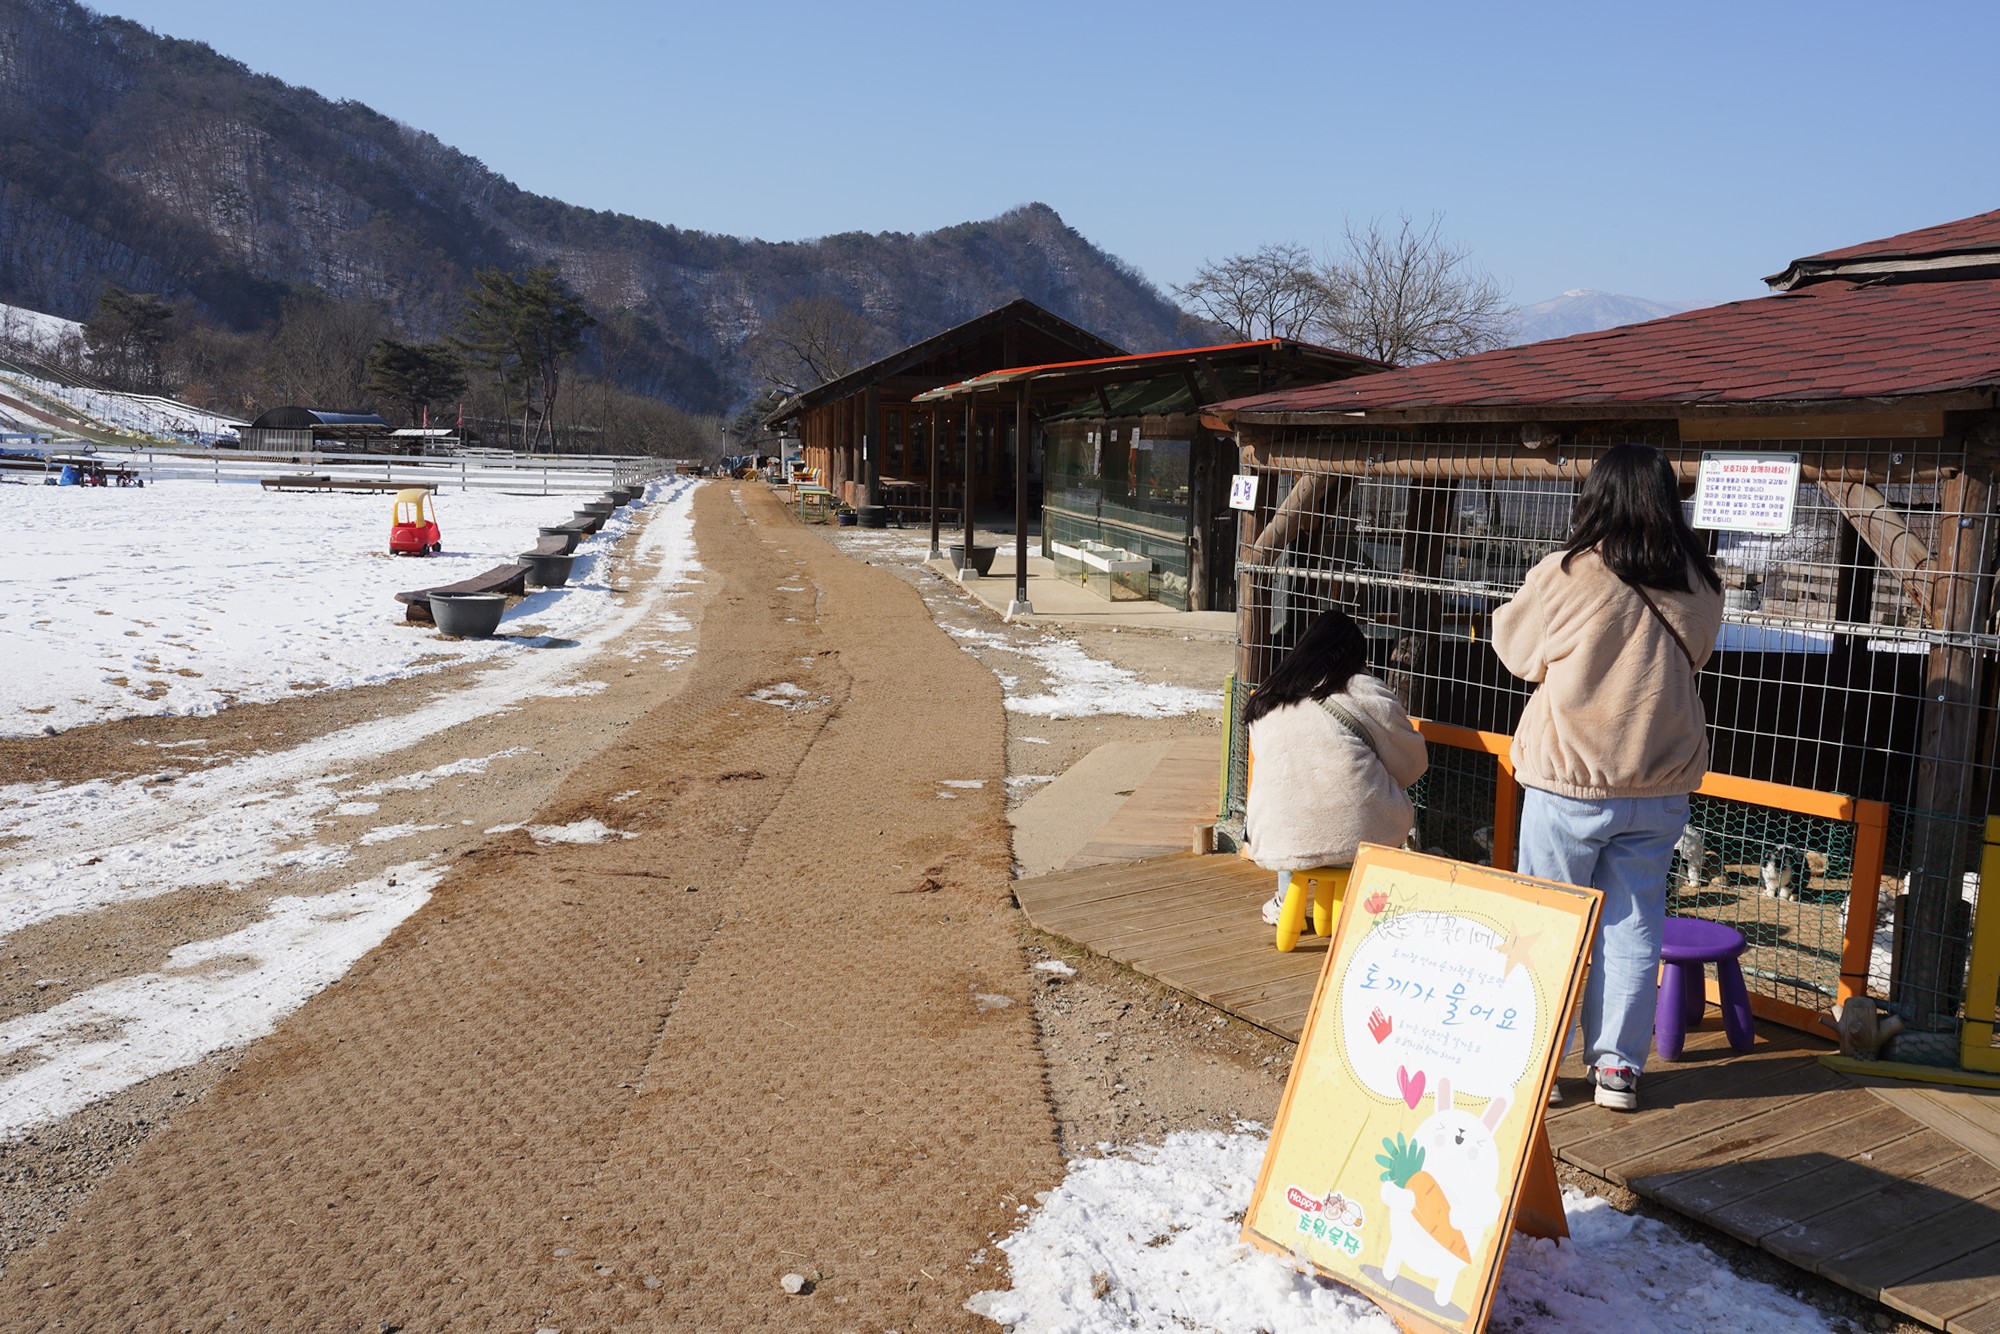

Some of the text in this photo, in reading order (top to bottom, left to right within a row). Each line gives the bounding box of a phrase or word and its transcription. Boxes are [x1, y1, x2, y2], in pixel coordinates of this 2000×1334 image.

[1723, 465, 1790, 474] 보호자와 함께하세요!!
[1360, 964, 1520, 1030] 토끼가 물어요
[1290, 1190, 1317, 1212] Happy
[1299, 1213, 1360, 1254] 초원목장
